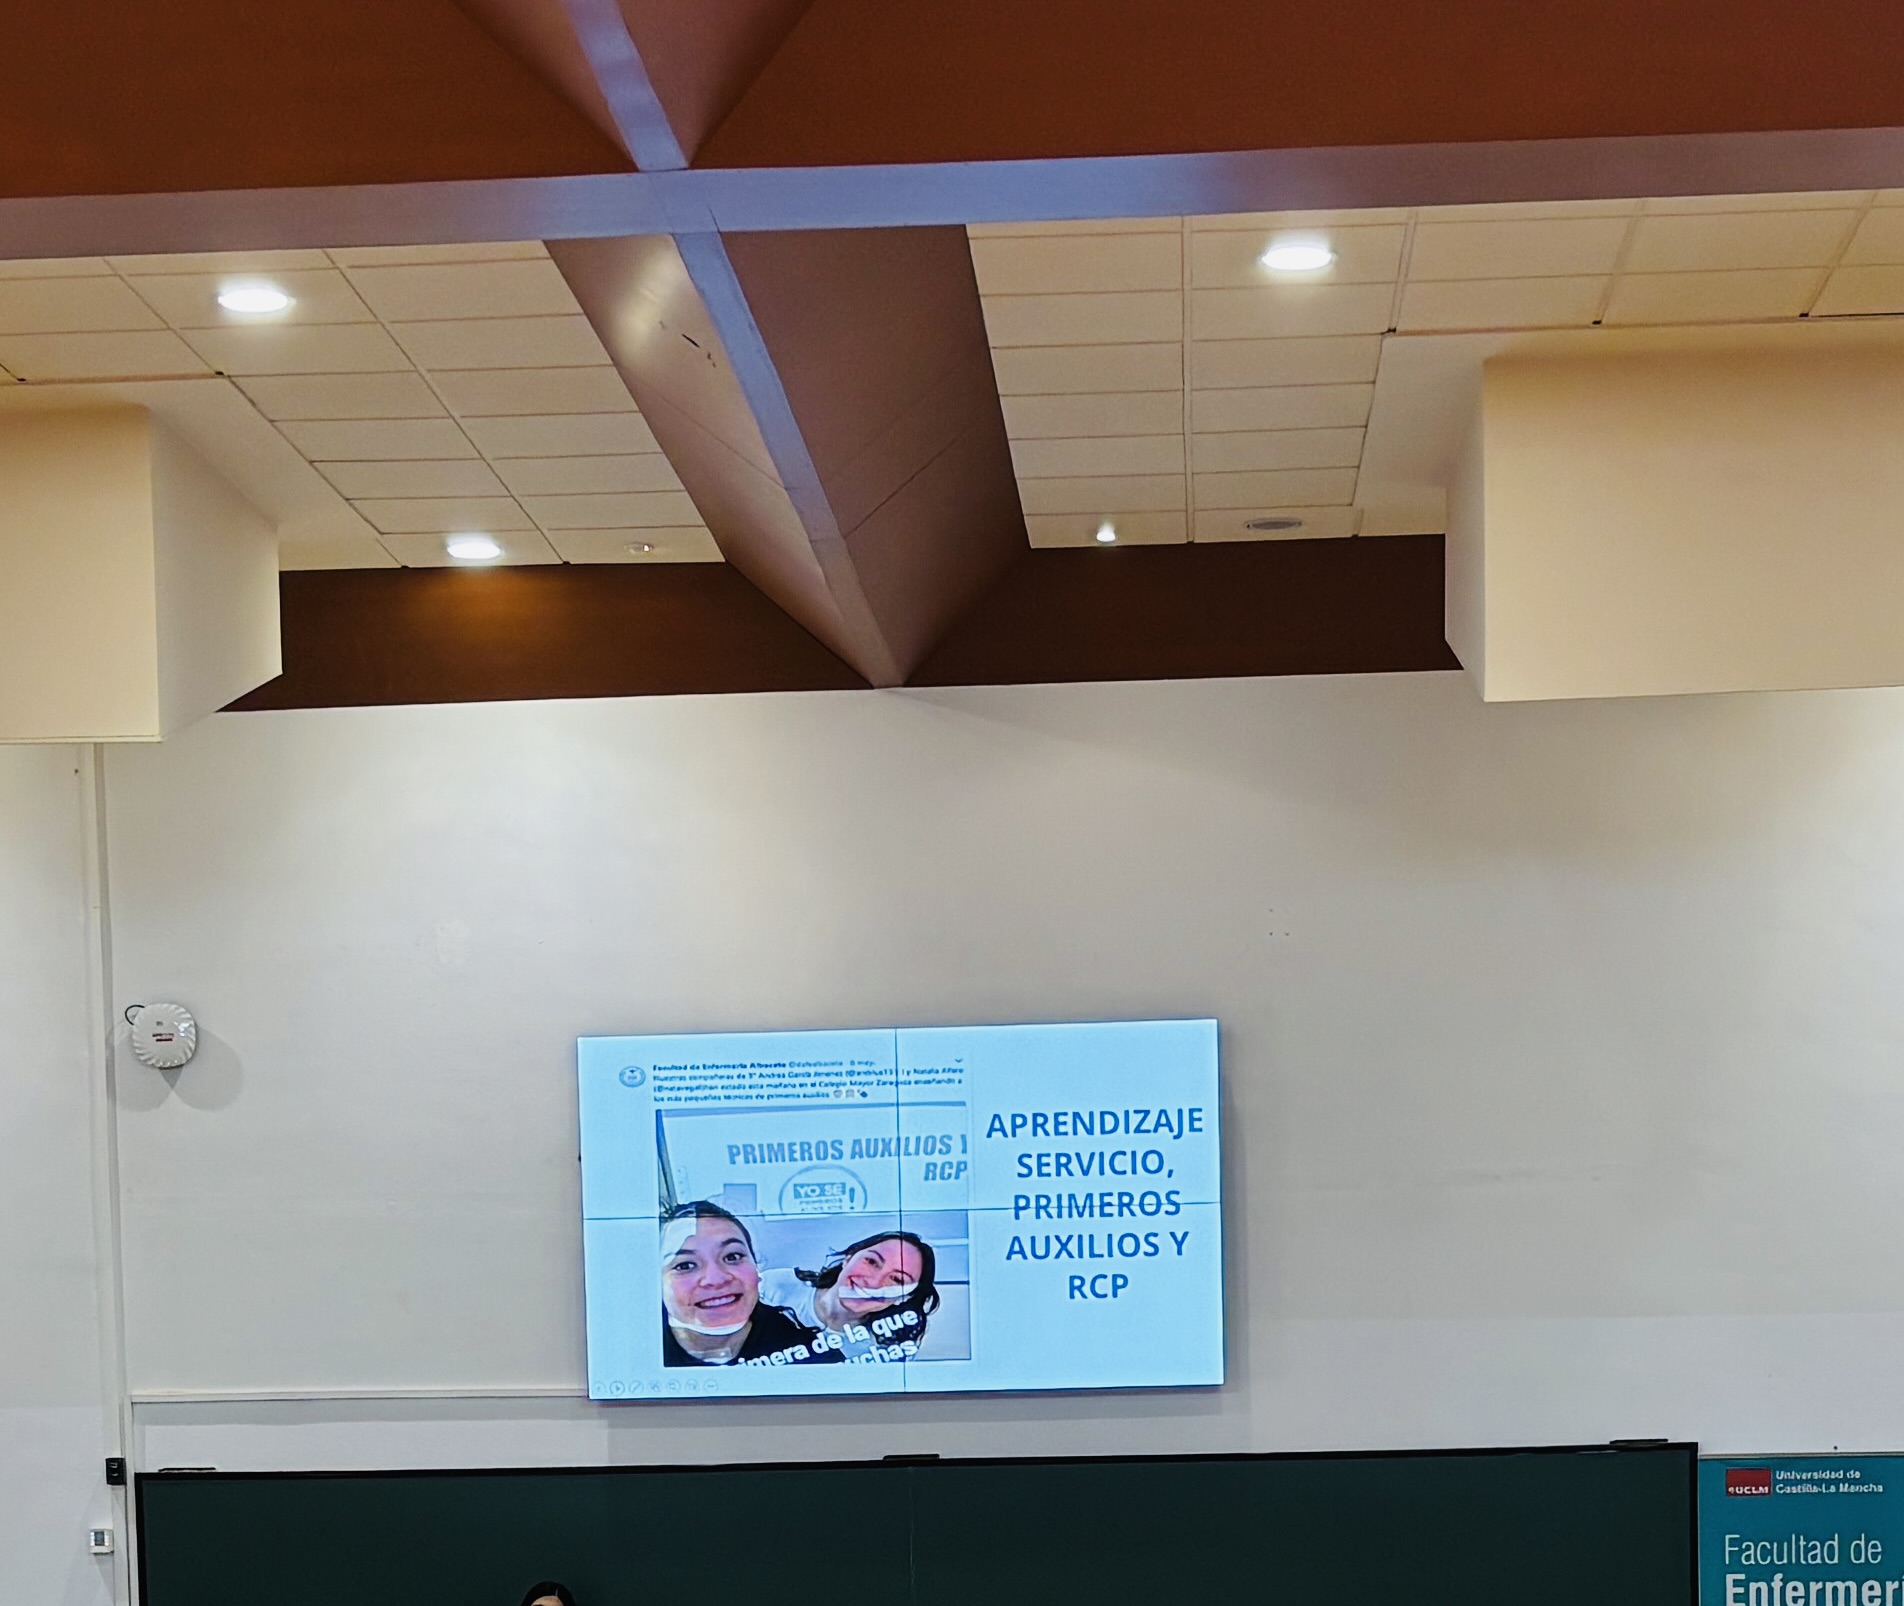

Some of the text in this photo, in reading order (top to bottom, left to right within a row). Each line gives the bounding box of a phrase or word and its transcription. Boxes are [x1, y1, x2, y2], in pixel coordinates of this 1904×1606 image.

[986, 1107, 1204, 1140] APRENDIZAJE
[727, 1140, 844, 1165] PRIMEROS
[850, 1134, 953, 1160] AUXILIOS
[1017, 1149, 1174, 1178] SERVICIO,
[924, 1160, 968, 1181] RCP
[1014, 1190, 1181, 1220] PRIMEROS
[1006, 1231, 1190, 1261] AUXILIOS Y
[1068, 1273, 1129, 1300] RCP
[812, 1332, 843, 1351] de
[845, 1324, 870, 1344] la
[871, 1309, 919, 1338] que
[1775, 1469, 1844, 1480] Universidad
[1724, 1533, 1882, 1565] Facultad de
